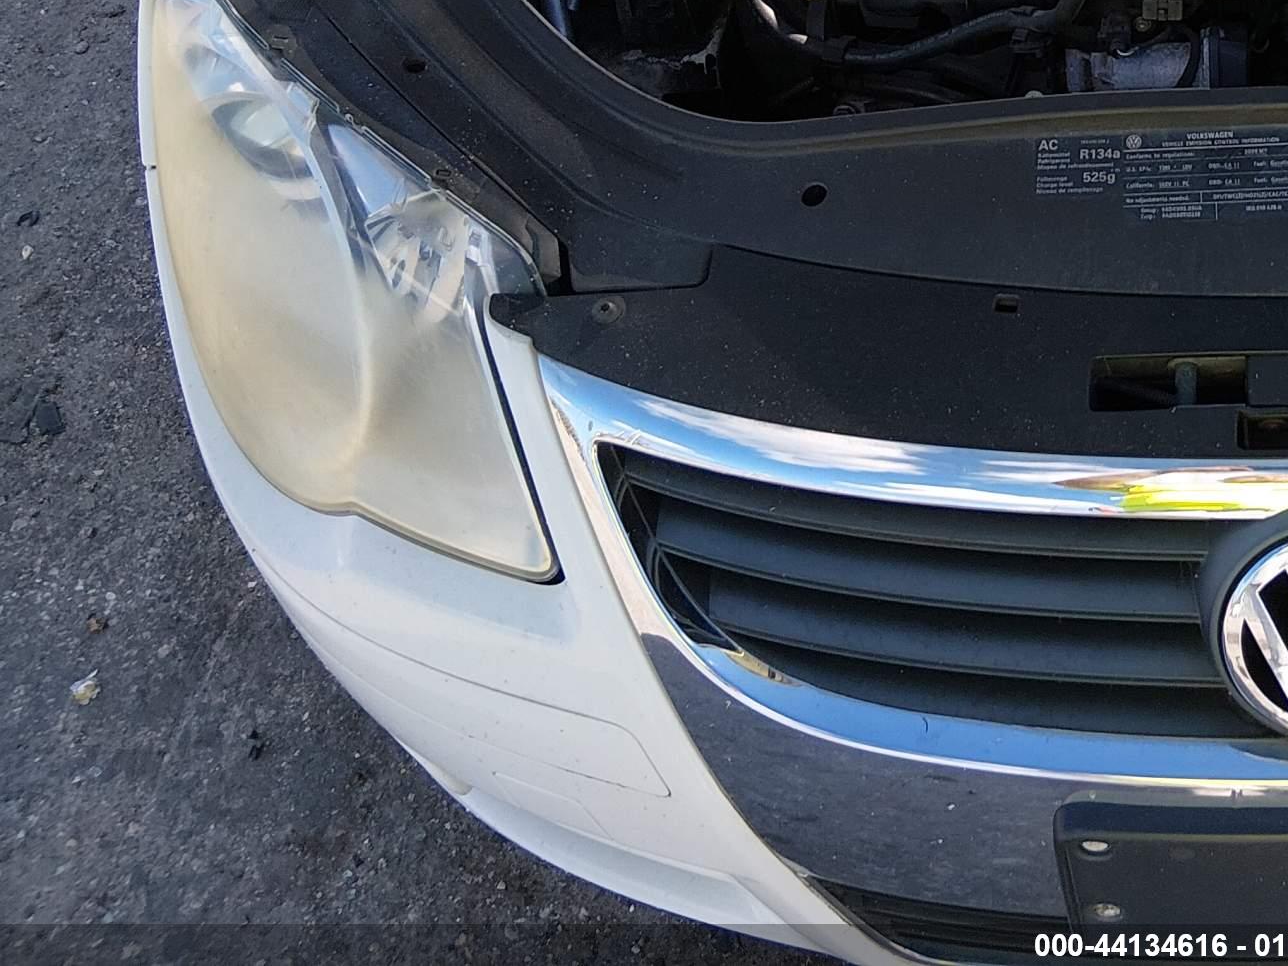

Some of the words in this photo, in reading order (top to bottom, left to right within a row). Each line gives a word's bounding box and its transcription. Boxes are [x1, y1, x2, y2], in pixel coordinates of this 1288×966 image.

[1186, 131, 1234, 140] VOLKSWAGEN
[1038, 139, 1058, 151] AC
[1080, 148, 1121, 160] R134a
[1083, 171, 1116, 184] 525g
